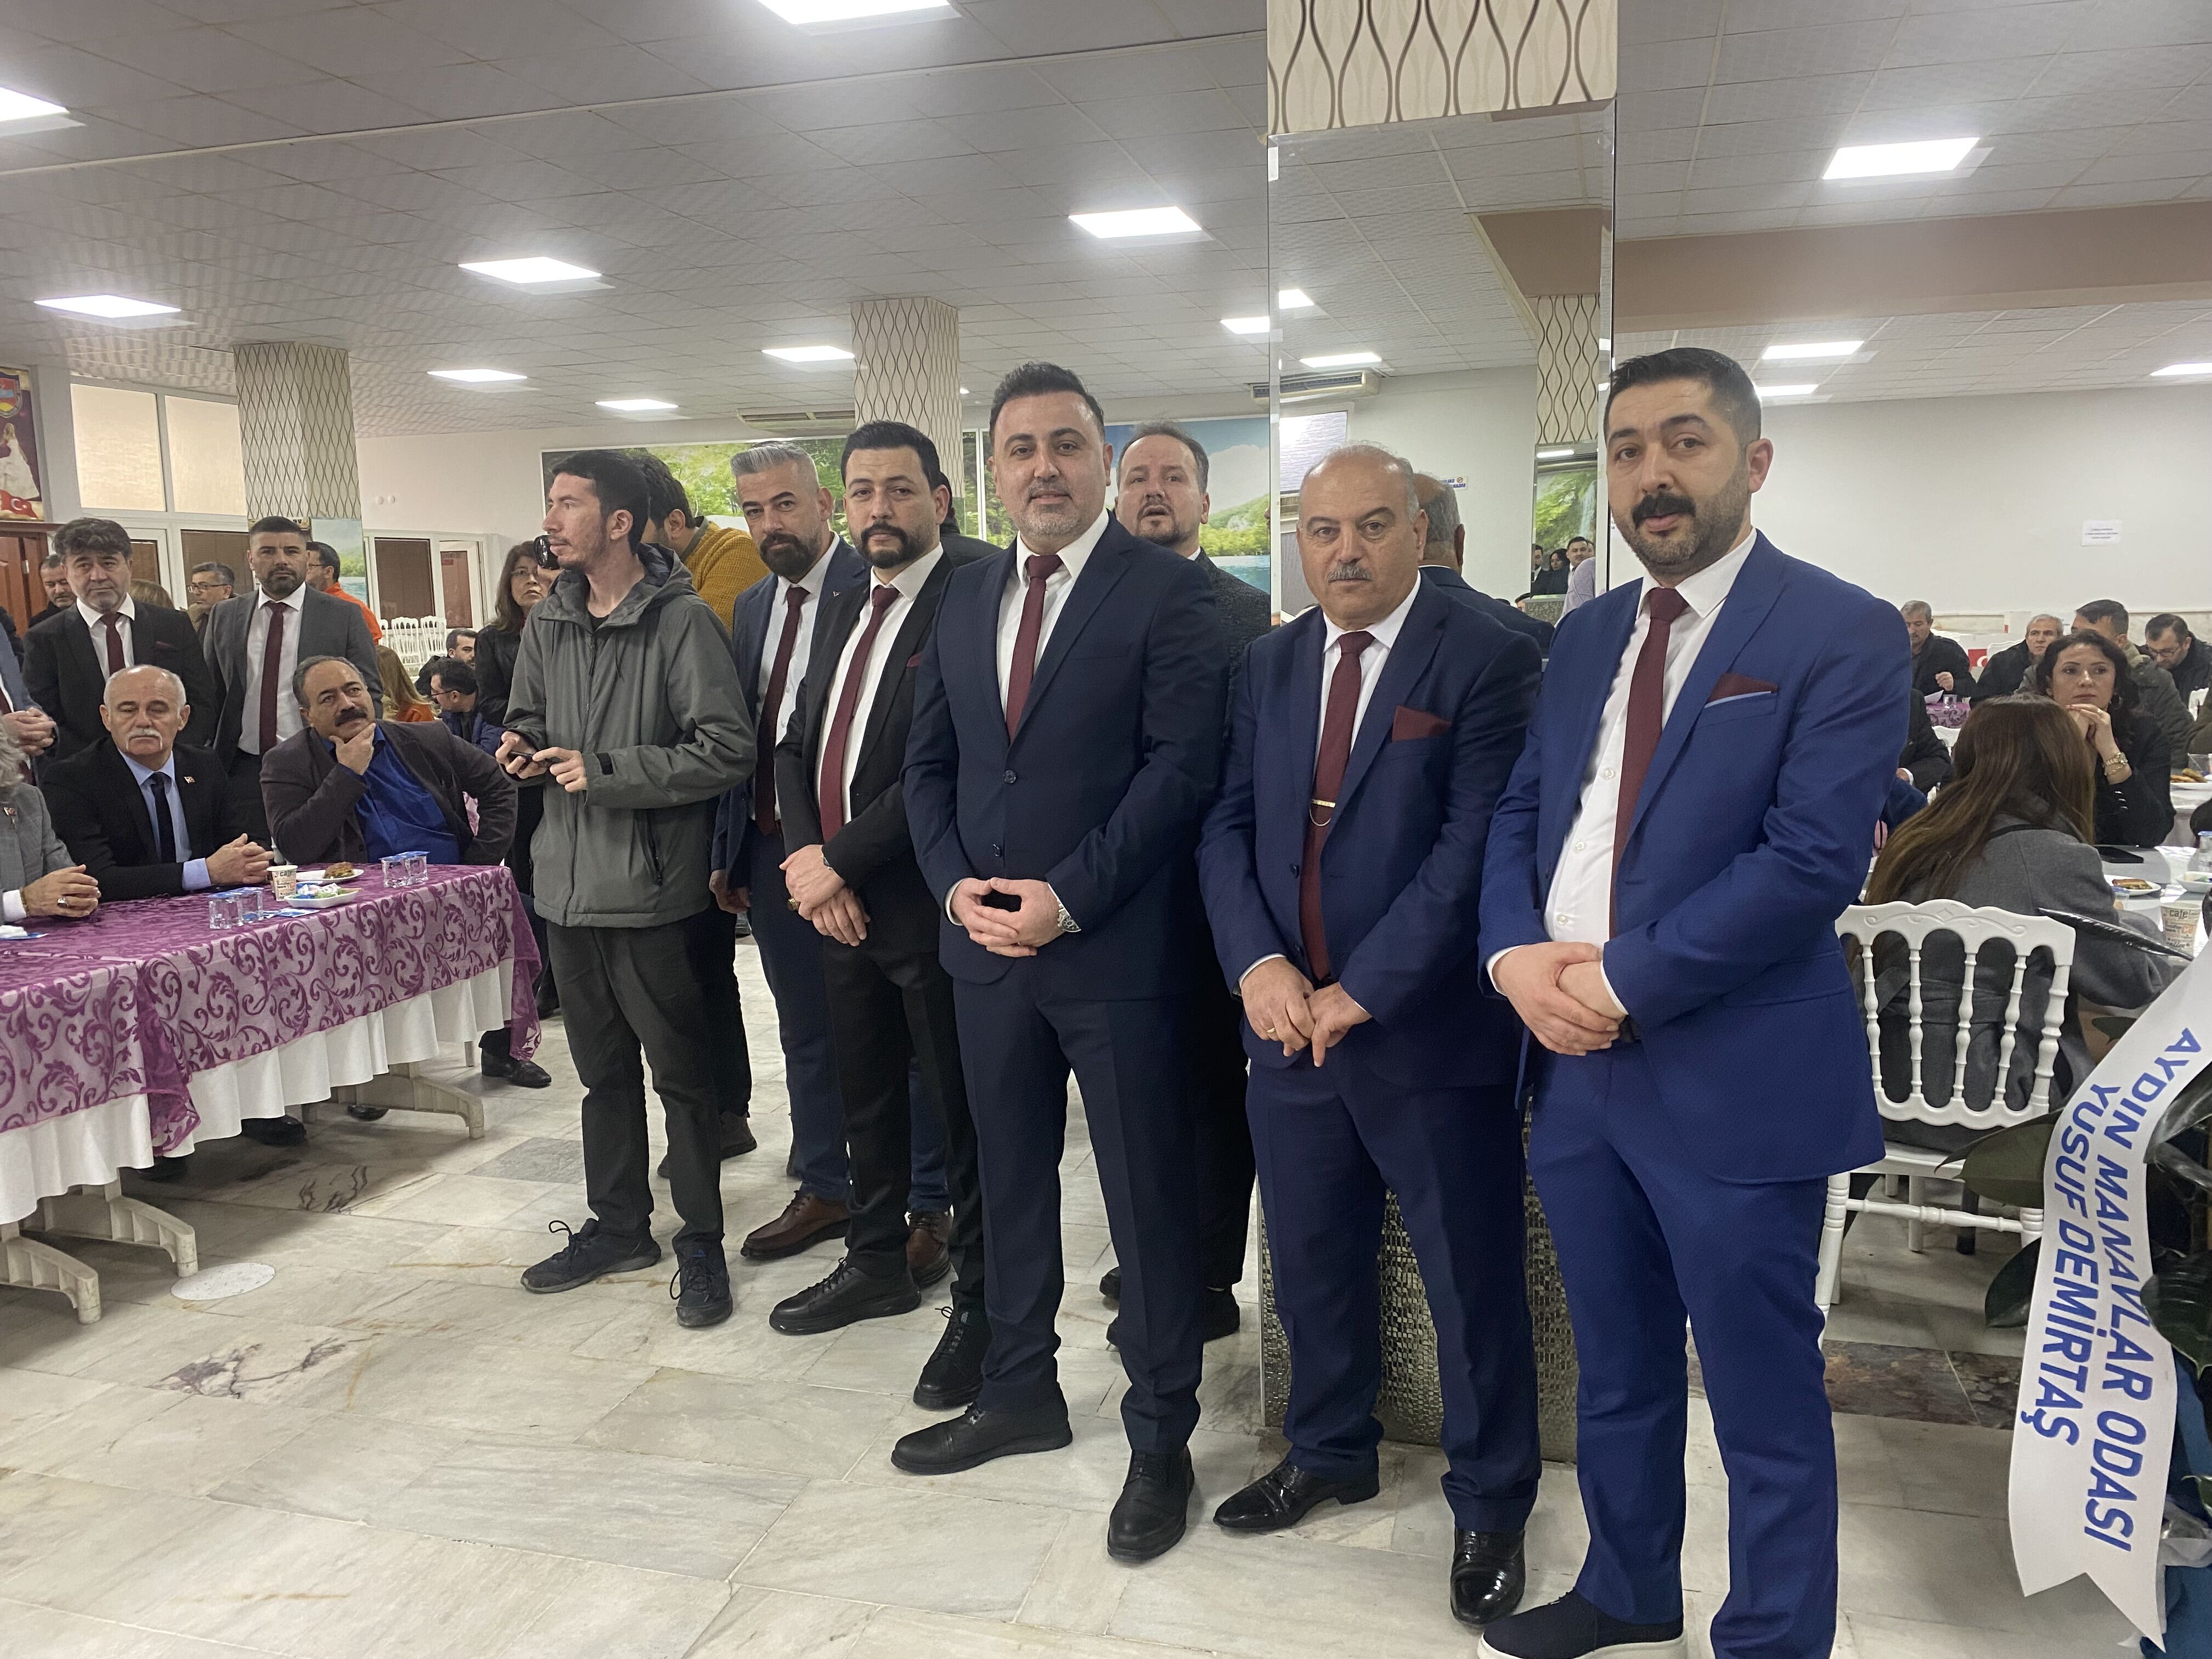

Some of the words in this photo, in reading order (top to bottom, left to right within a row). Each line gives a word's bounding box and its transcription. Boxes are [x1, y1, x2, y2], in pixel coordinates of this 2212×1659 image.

[2169, 909, 2188, 919] cafe
[2055, 1084, 2121, 1218] YUSUF
[2103, 1028, 2202, 1150] AYDIN
[2021, 1220, 2107, 1446] DEMİRTAŞ
[2095, 1154, 2153, 1400] MANAVLAR
[2085, 1410, 2146, 1551] ODASI
